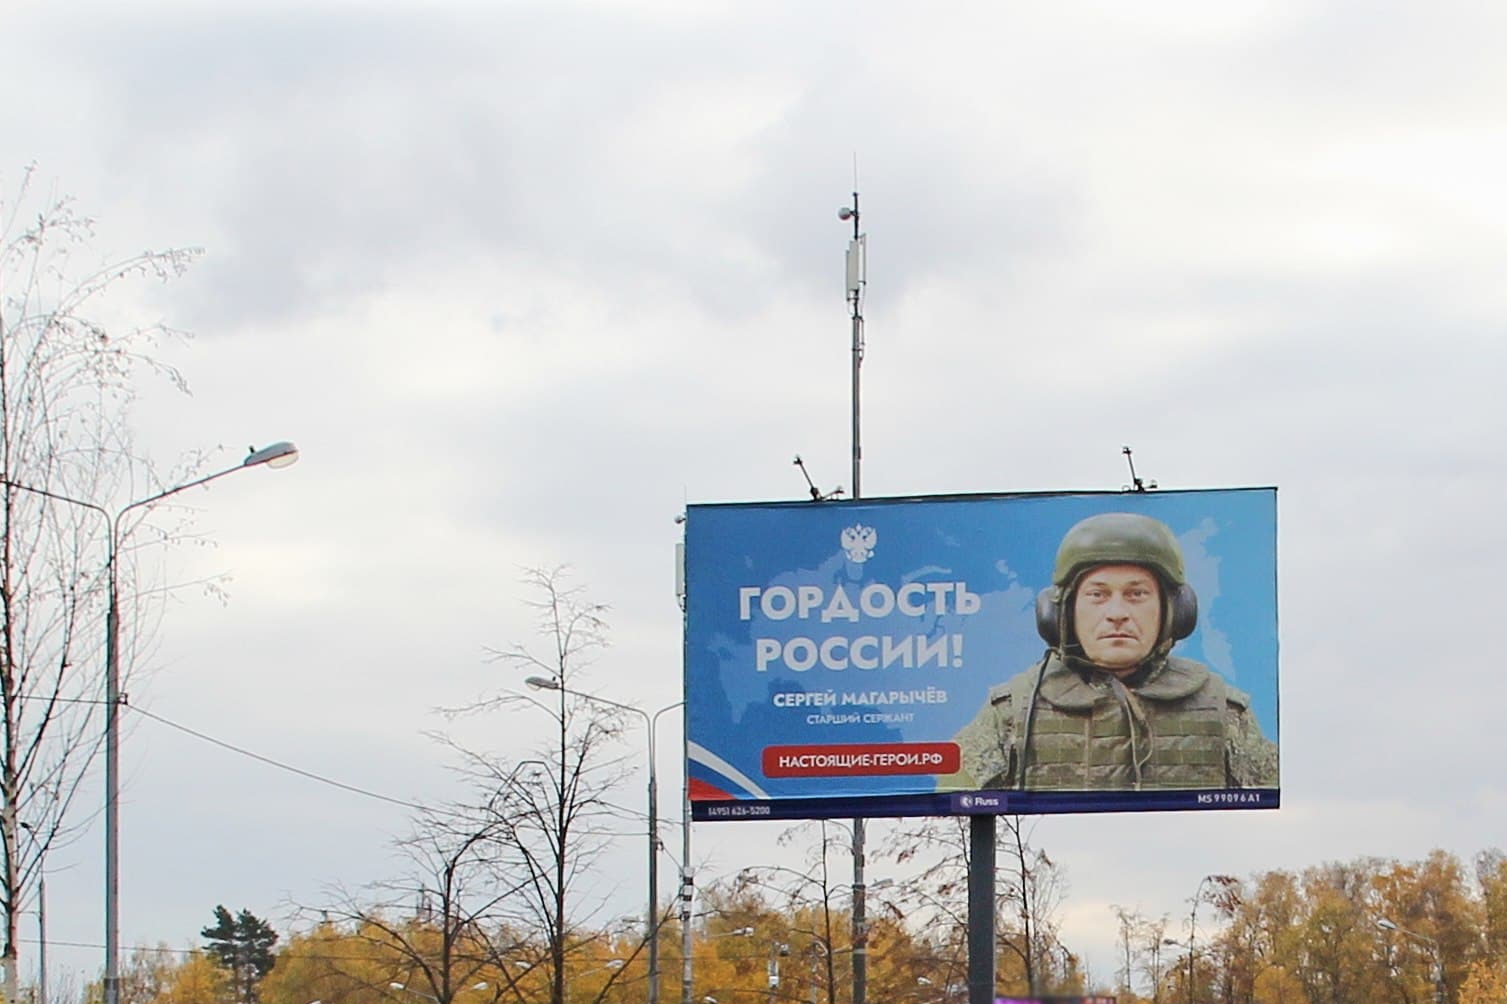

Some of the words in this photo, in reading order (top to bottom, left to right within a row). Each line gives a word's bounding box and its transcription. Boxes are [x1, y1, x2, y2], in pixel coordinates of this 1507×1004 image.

[739, 582, 982, 623] ГОРДОСТЬ
[756, 634, 963, 672] РОССИИ!
[773, 689, 837, 707] СЕРГЕЙ
[842, 686, 948, 705] МАГАРЫЧЁВ
[806, 712, 861, 725] СТАРШИЙ
[863, 713, 915, 724] СЕРЖАНТ
[779, 752, 943, 768] НАСТОЯЩИЕ-ГЕРОИ.РФ
[974, 796, 999, 807] Russ
